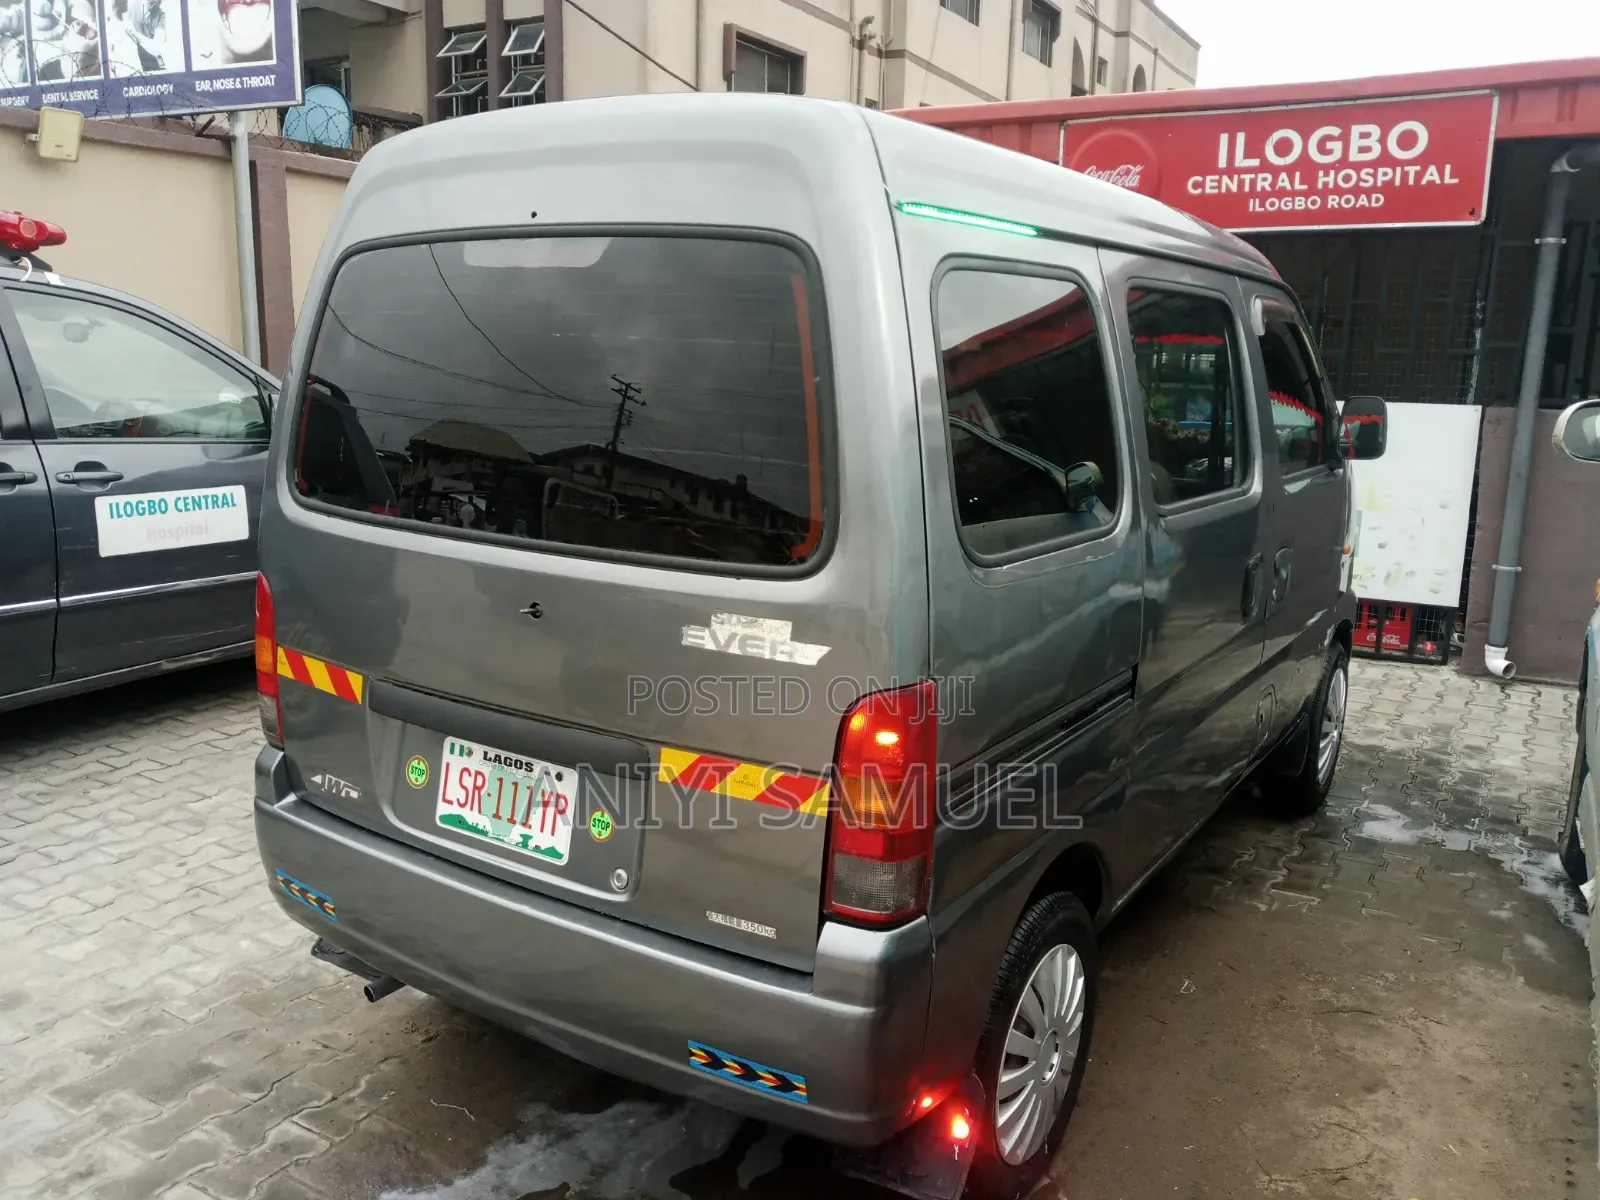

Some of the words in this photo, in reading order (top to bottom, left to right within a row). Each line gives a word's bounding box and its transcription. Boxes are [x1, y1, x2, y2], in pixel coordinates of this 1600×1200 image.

[122, 84, 174, 97] CARDIOLOGY
[195, 80, 213, 92] EAR,
[213, 79, 235, 90] NOSE
[235, 78, 242, 89] &
[242, 75, 276, 87] THROAT
[42, 91, 69, 104] DENTAL
[69, 89, 99, 102] SERVICE
[1218, 120, 1429, 168] ILOGBO
[1084, 164, 1145, 187] Coca-Cola
[1187, 171, 1308, 195] CENTRAL
[1317, 165, 1459, 189] HOSPITAL
[1248, 196, 1321, 212] ILOGBO
[1328, 193, 1385, 209] ROAD
[108, 498, 168, 519] ILOGBO
[174, 492, 236, 513] CENTRAL
[410, 764, 426, 777] STOP
[483, 750, 534, 773] LAGOS
[592, 817, 611, 831] STOP
